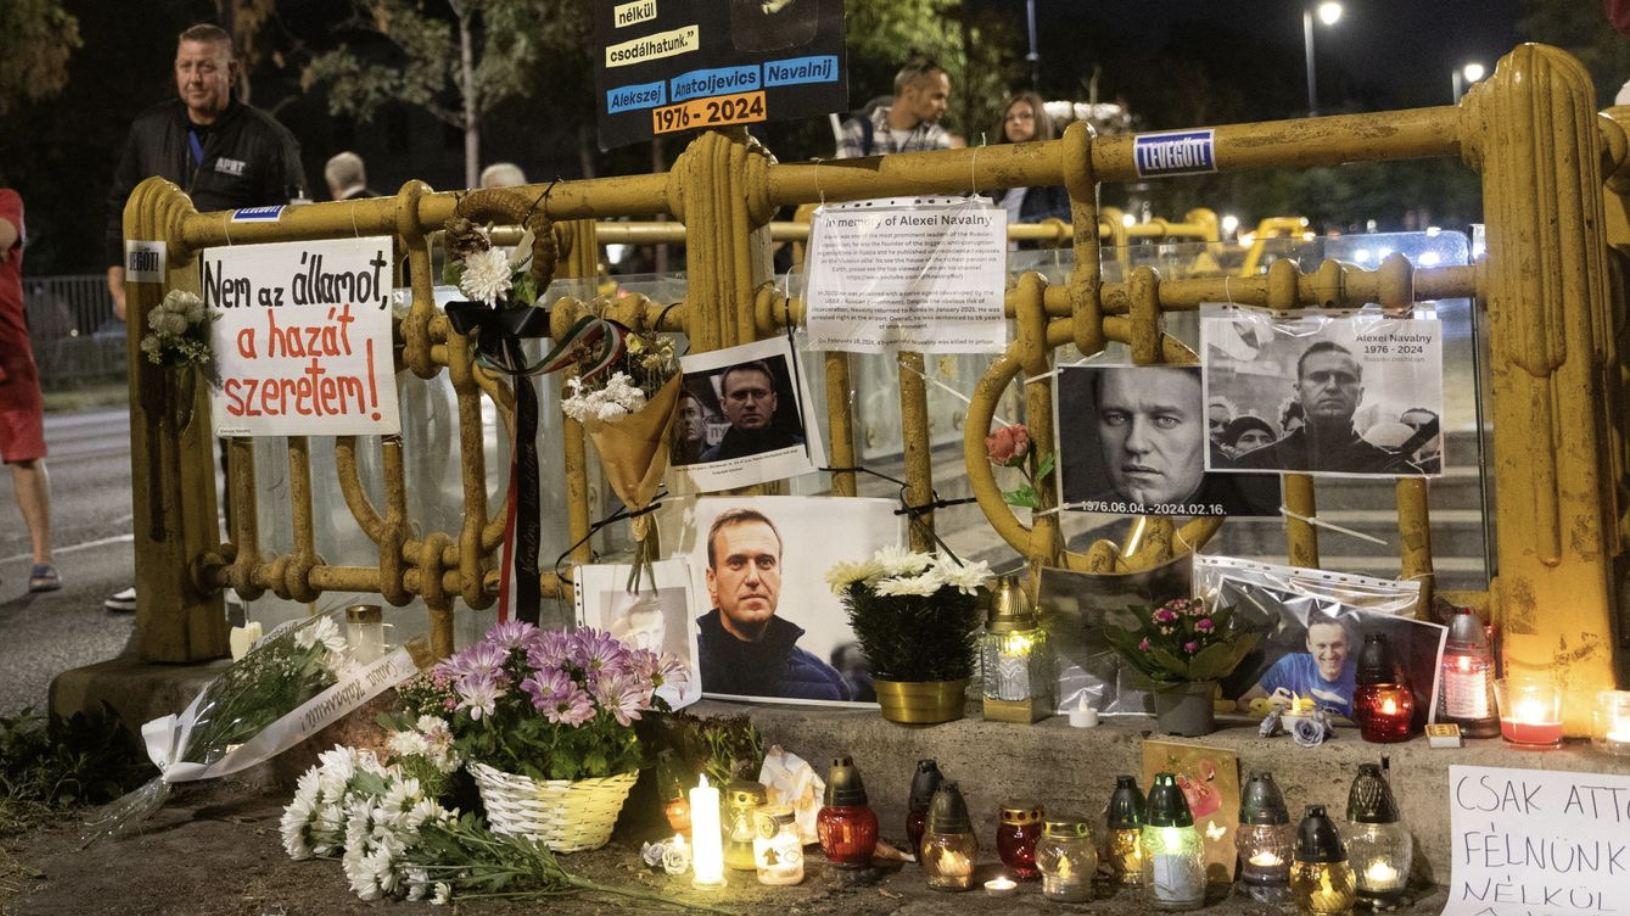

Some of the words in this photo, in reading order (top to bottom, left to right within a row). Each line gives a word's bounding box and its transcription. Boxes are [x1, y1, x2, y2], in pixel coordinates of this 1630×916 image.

[618, 1, 654, 25] nélkül
[610, 31, 695, 63] csodálhatunk.”
[611, 85, 662, 109] Alekszej
[674, 70, 757, 98] Anatoljevics
[767, 58, 832, 82] Navalnij
[655, 108, 689, 131] 1976
[706, 96, 764, 123] 2024
[885, 215, 897, 226] of
[900, 214, 938, 226] Alexei
[941, 213, 993, 228] Navalny
[204, 260, 251, 309] Nem
[257, 287, 285, 308] az
[292, 250, 388, 311] államot,
[237, 327, 258, 360] a
[267, 303, 355, 359] hazát
[1355, 333, 1387, 343] Alexei
[1389, 333, 1433, 345] Navalny
[1364, 345, 1389, 354] 1976
[1397, 345, 1424, 354] 2024
[223, 337, 382, 422] szeretem!
[1082, 500, 1228, 516] 1976.06.04.-2024.02.16.
[1456, 774, 1543, 815] CSAK
[1563, 784, 1630, 823] ATT
[1463, 821, 1627, 876] FÉLNÜNK
[1462, 874, 1618, 912] NÉLKÜL
